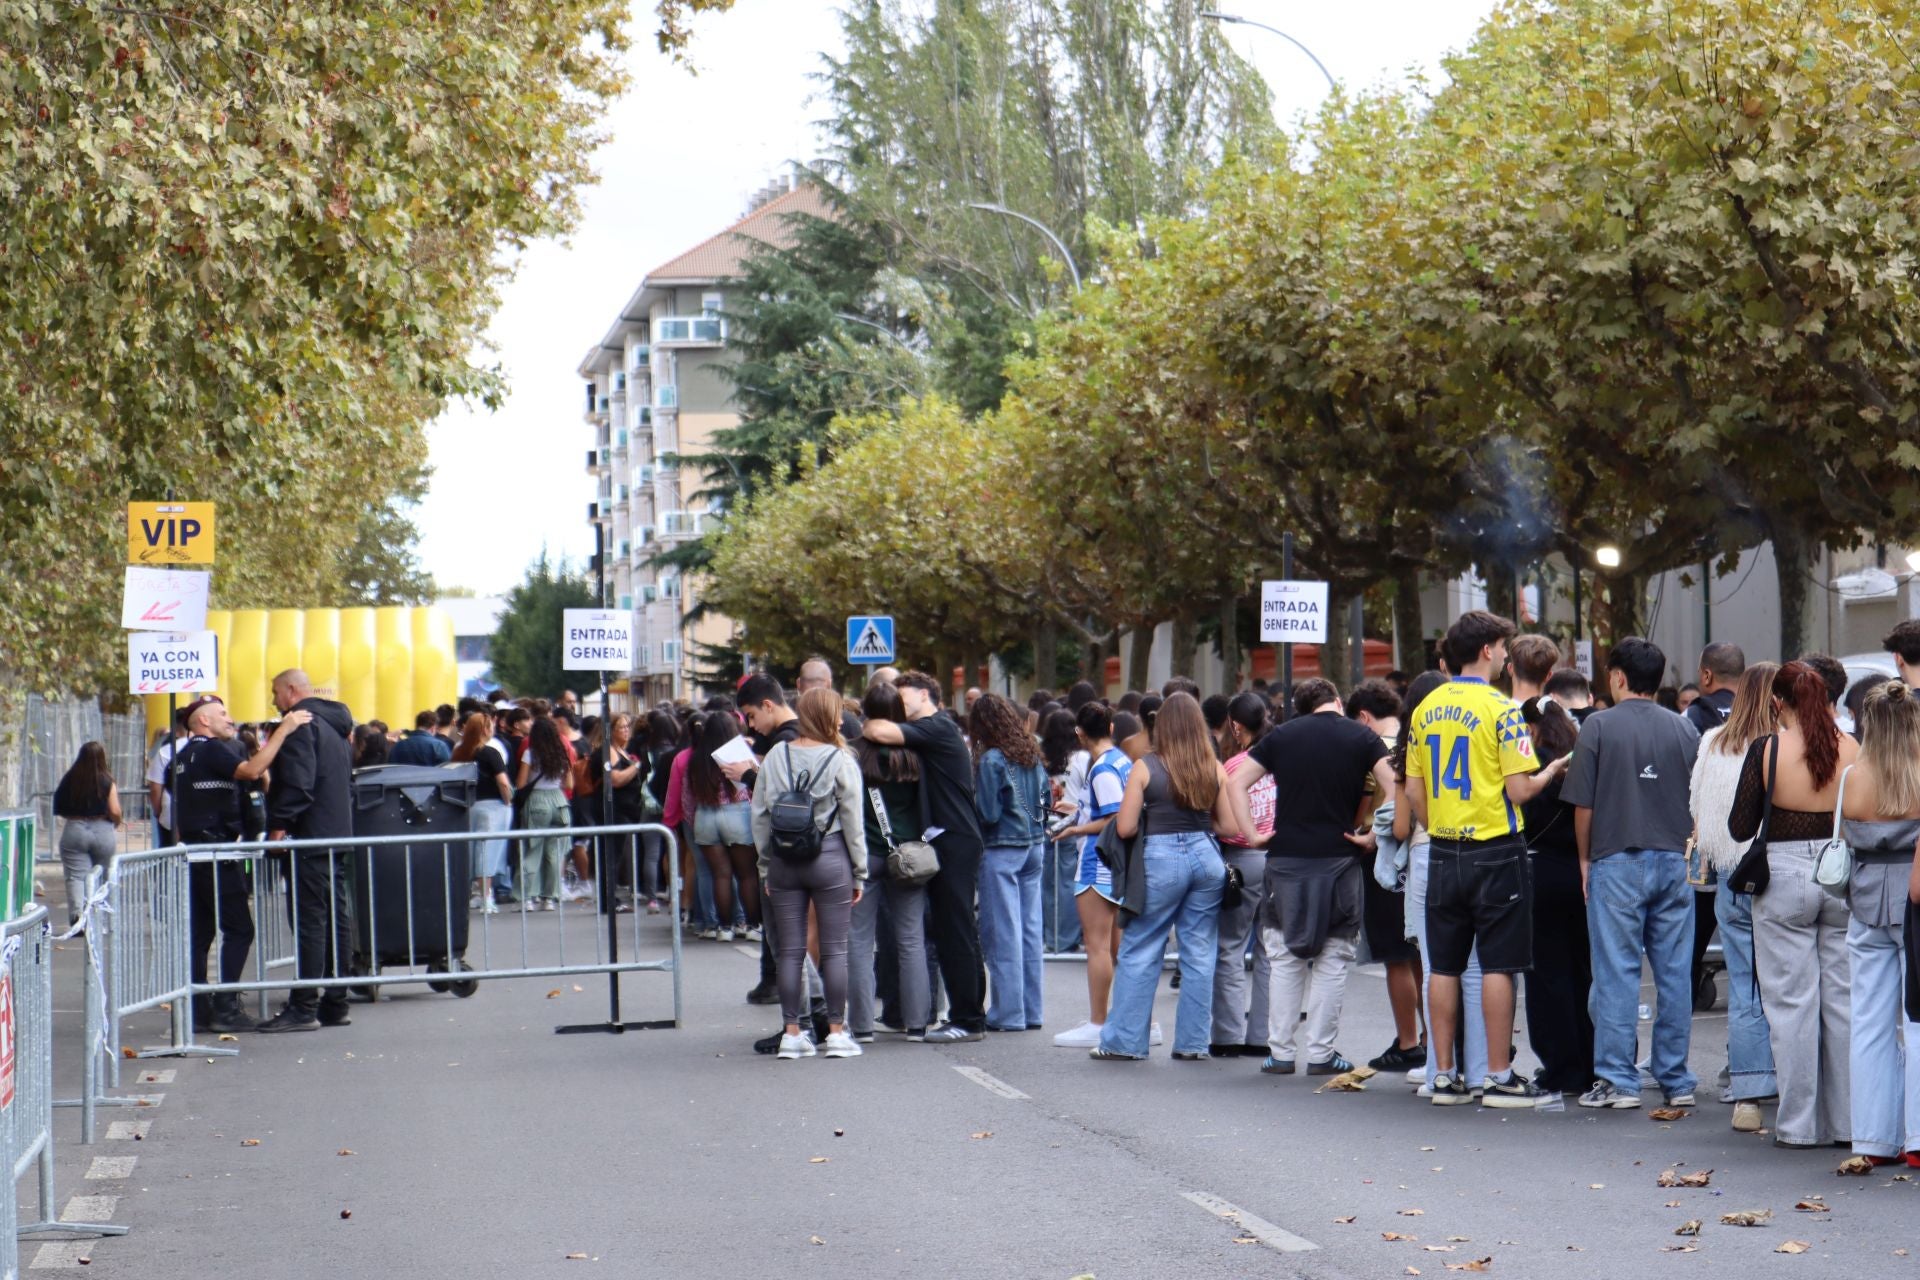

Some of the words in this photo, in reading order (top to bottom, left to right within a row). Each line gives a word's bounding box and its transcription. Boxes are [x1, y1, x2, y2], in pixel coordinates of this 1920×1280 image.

[141, 519, 201, 547] VIP
[1264, 600, 1318, 613] ENTRADA
[1264, 618, 1318, 631] GENERAL
[570, 628, 628, 641] ENTRADA
[141, 651, 159, 663] YA
[165, 650, 199, 662] CON
[571, 647, 628, 659] GENERAL
[141, 668, 204, 681] PULSERA
[1424, 734, 1472, 800] 14
